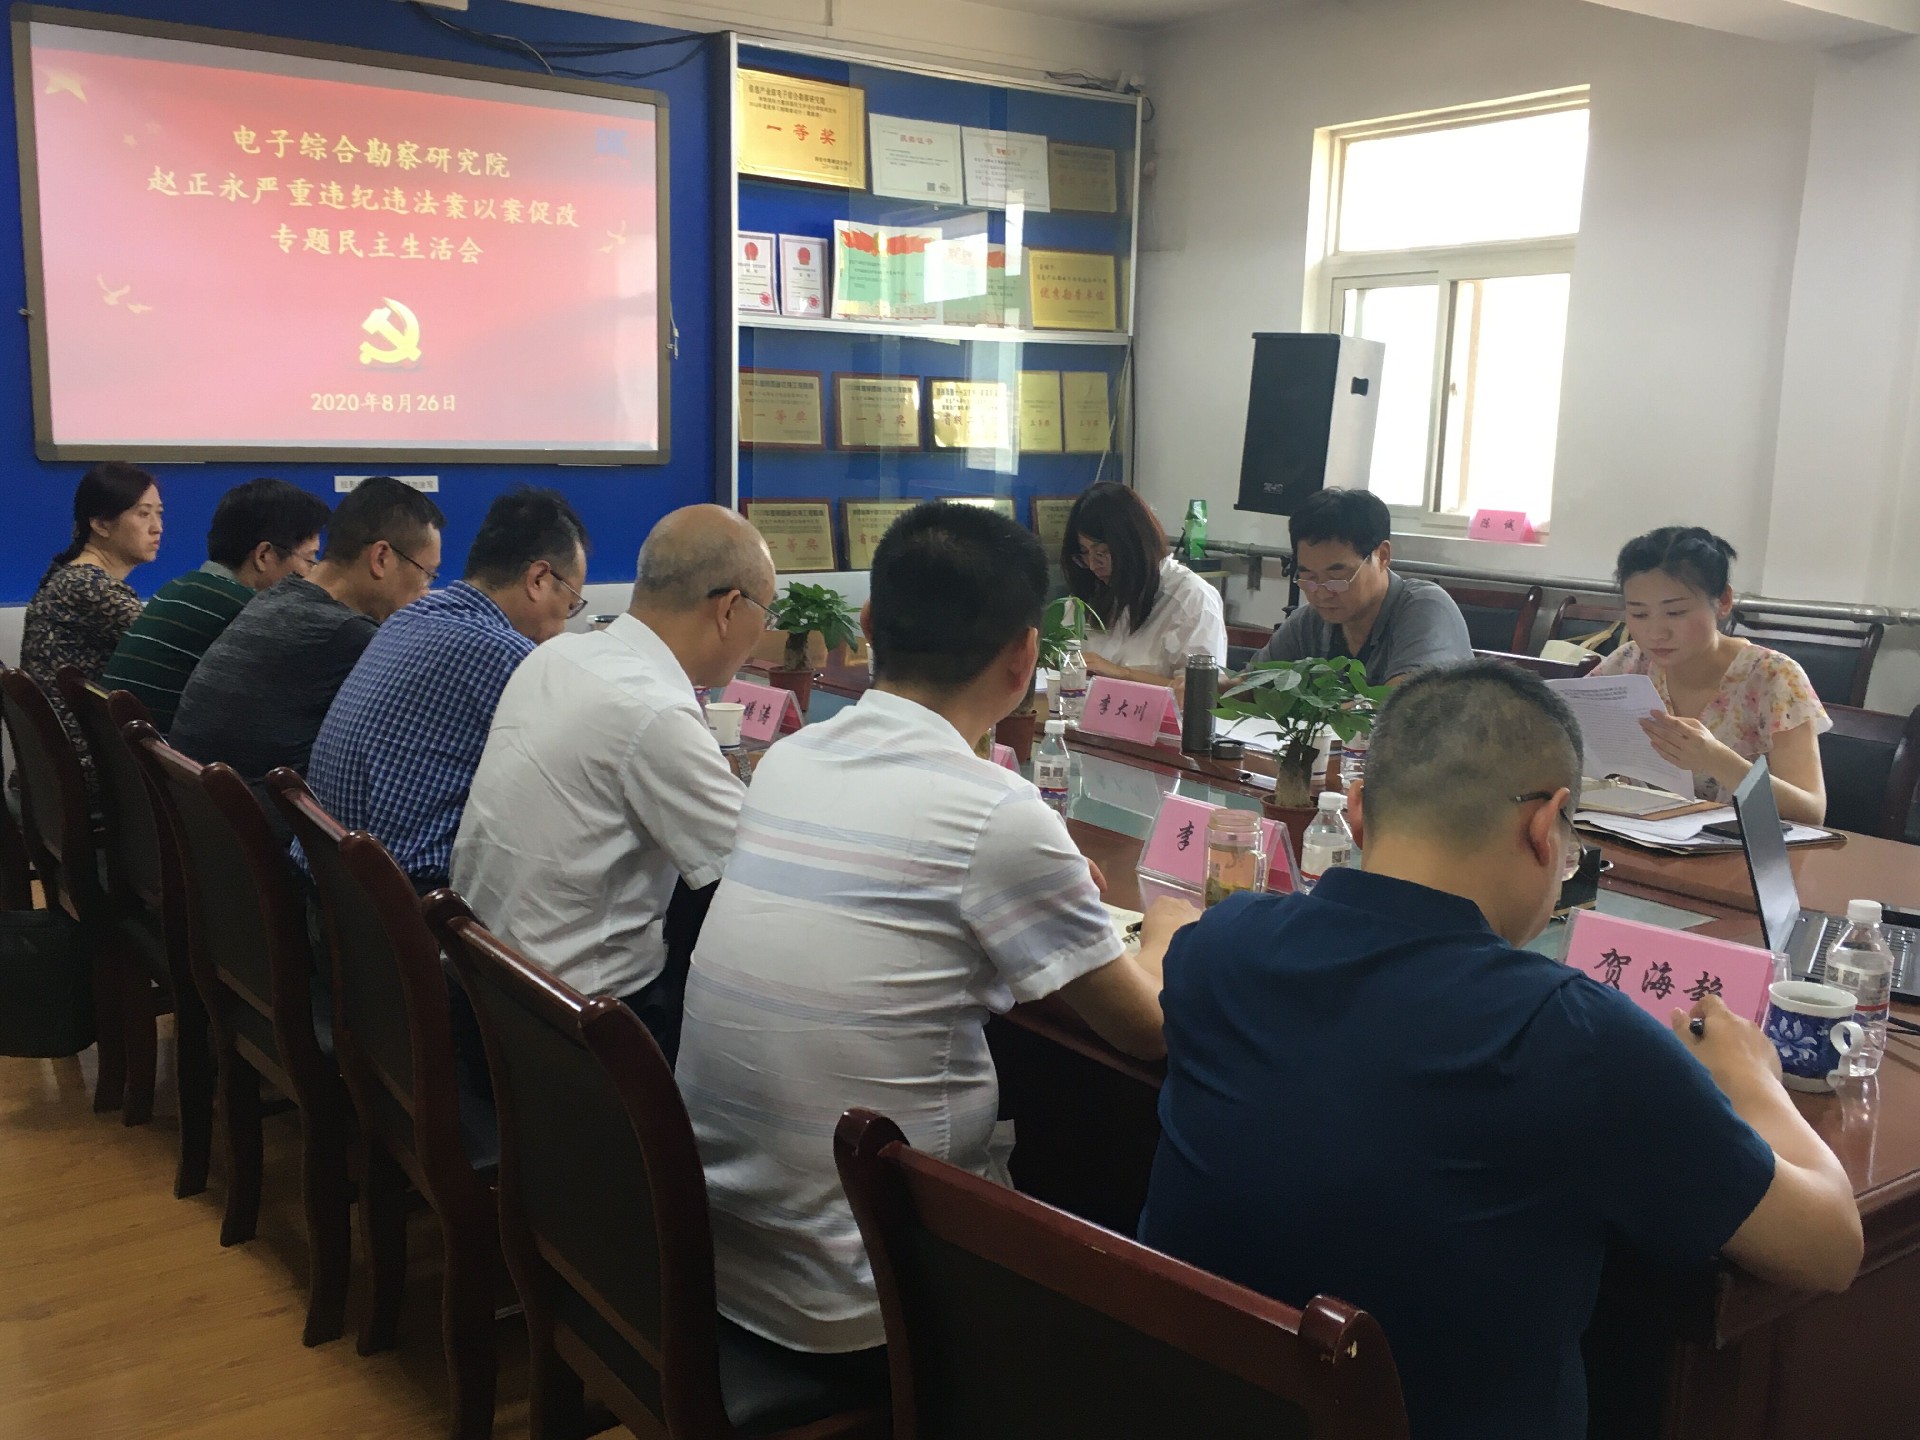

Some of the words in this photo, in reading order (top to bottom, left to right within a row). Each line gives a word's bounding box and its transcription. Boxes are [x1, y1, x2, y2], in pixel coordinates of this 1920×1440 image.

[766, 123, 836, 145] 一等奖
[232, 124, 511, 179] 电子综合勘察研究院
[146, 164, 581, 229] 赵正永严重违纪违法案以案促改
[270, 222, 485, 264] 专题民主生活会
[310, 391, 456, 413] 2020年8月26日
[753, 409, 808, 424] 一等奖
[1099, 693, 1149, 722] 李大川
[1177, 820, 1195, 852] 李
